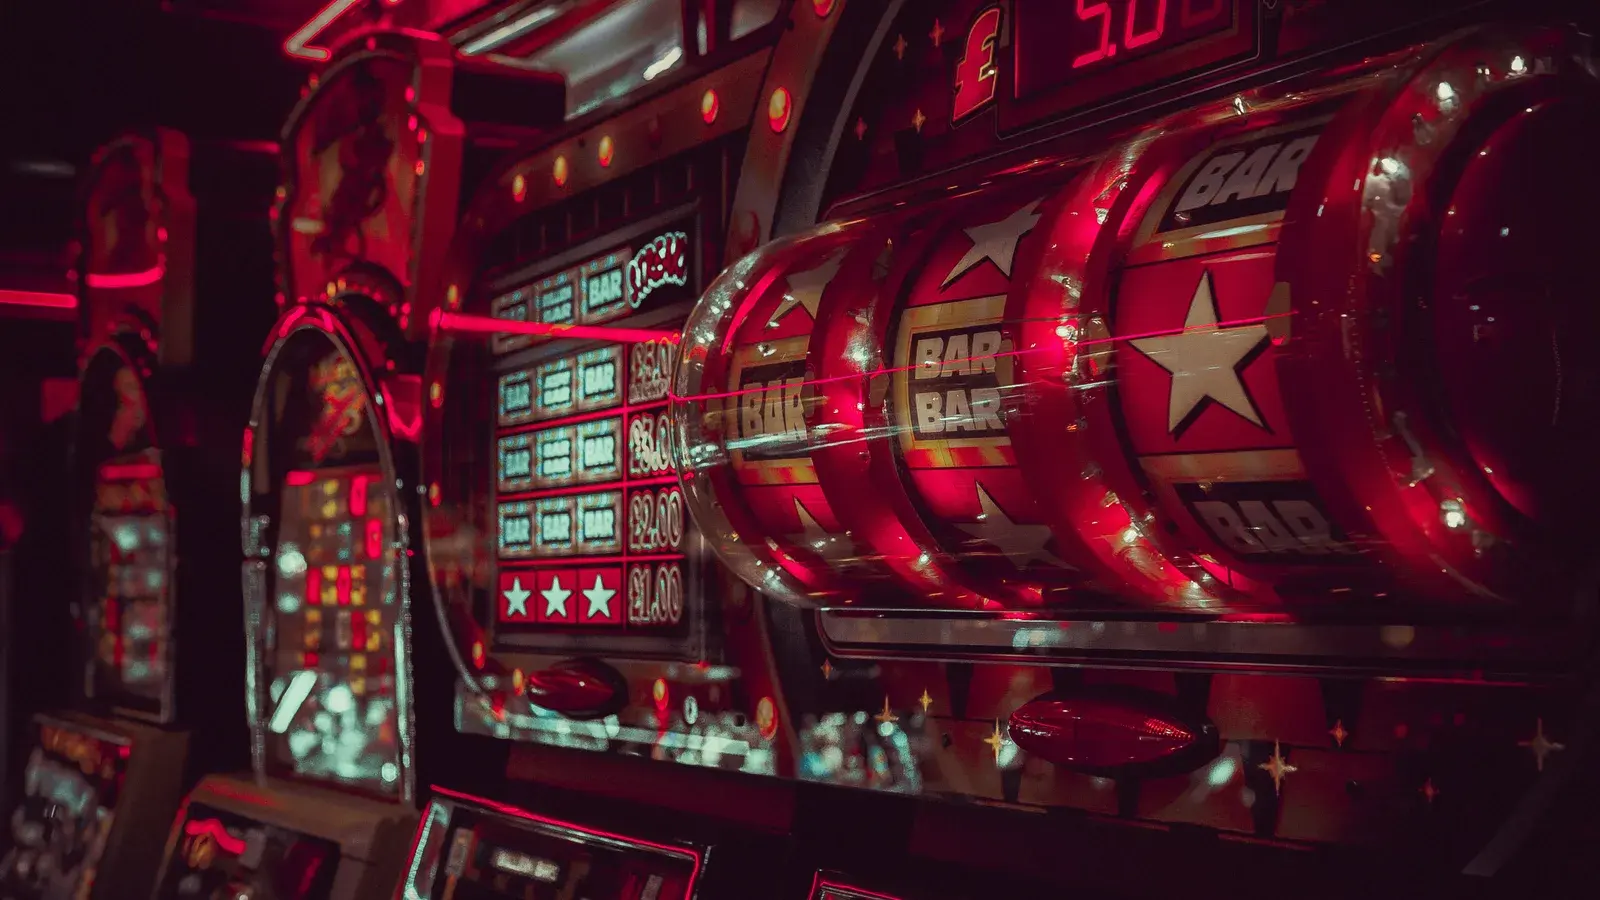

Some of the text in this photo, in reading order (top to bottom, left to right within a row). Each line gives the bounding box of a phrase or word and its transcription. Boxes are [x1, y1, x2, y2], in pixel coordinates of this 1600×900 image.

[953, 8, 1000, 121] £
[1174, 134, 1321, 214] BAR
[588, 268, 622, 308] BAR
[585, 363, 614, 395] BAR
[631, 338, 678, 385] £5.0
[914, 331, 1002, 380] BAR
[742, 376, 808, 441] BAR
[914, 387, 1006, 433] BAR
[585, 436, 614, 467] BAR
[630, 413, 677, 474] £3.0
[543, 513, 570, 540] BAR
[584, 508, 614, 539] BAR
[630, 490, 683, 549] £2.00
[1192, 499, 1358, 556] BAR
[629, 565, 683, 622] £1.00
